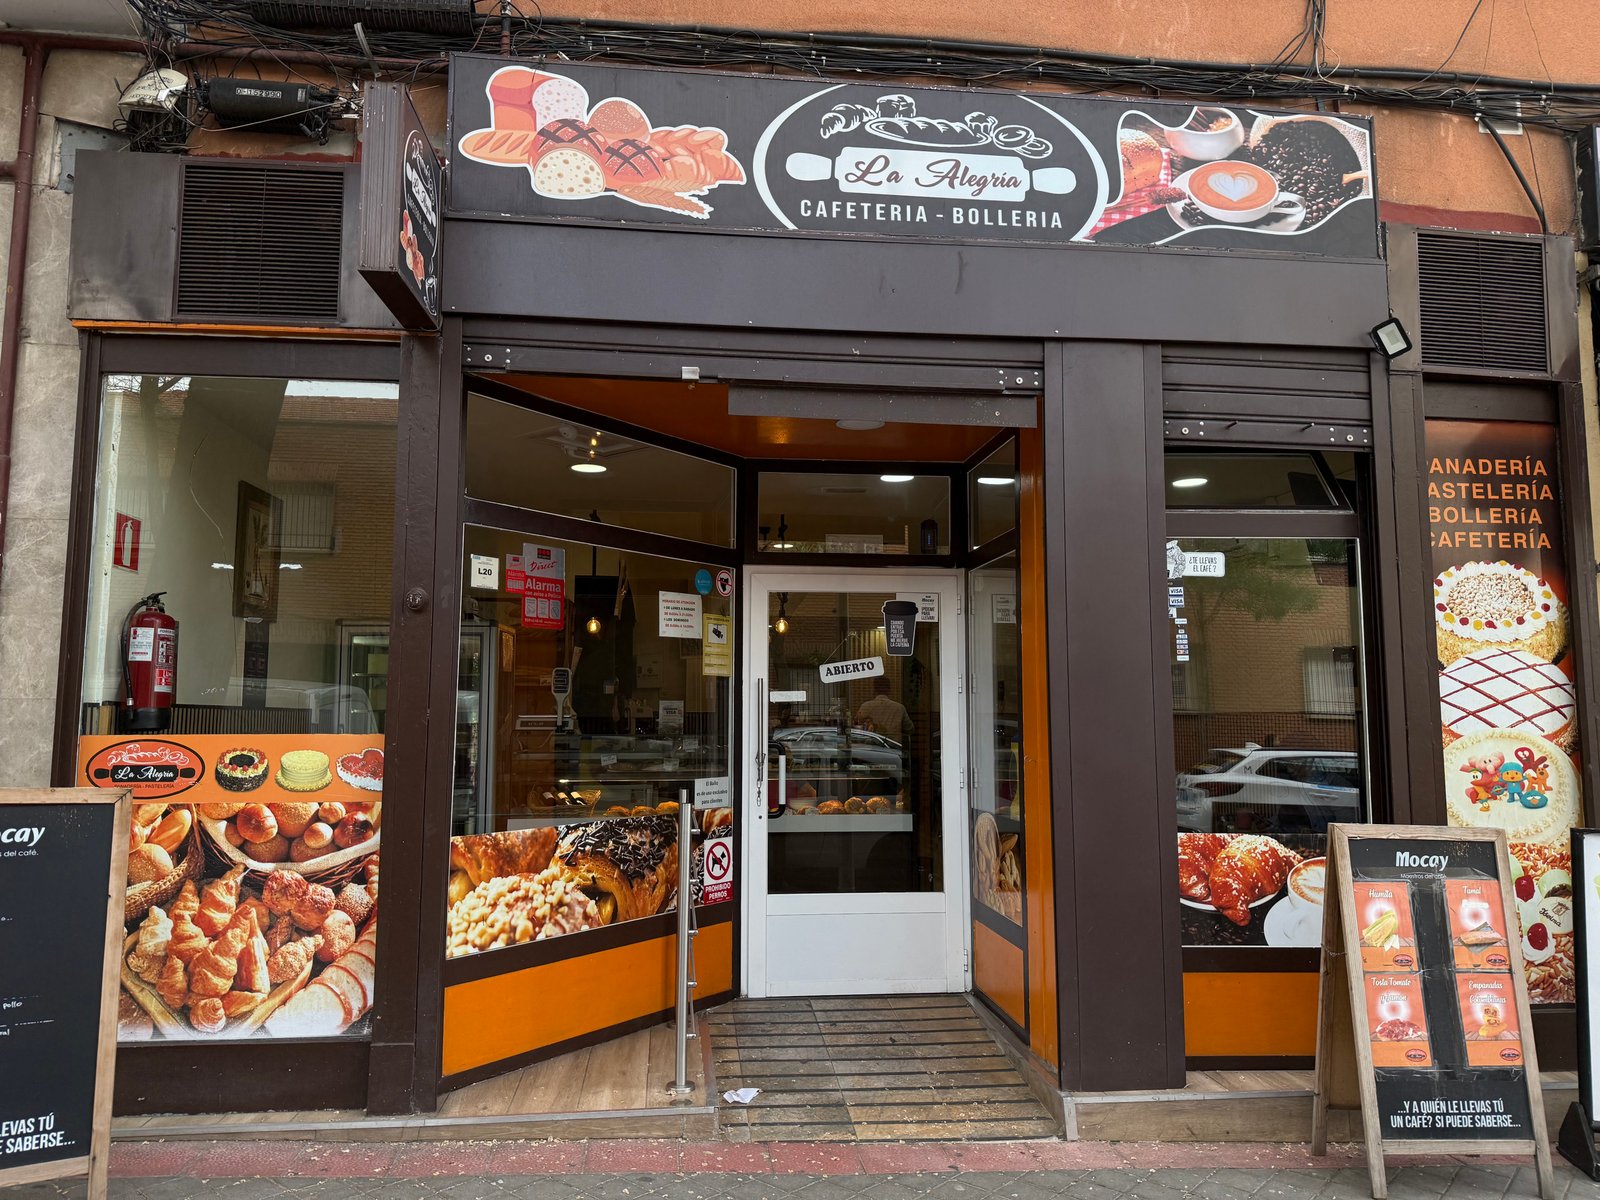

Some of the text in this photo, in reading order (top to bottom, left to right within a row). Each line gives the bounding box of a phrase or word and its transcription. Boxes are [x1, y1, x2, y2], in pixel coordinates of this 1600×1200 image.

[845, 155, 1022, 197] La Alegría
[800, 199, 928, 223] CAFETERIA
[952, 207, 1063, 229] BOLLERIA
[1427, 456, 1548, 476] ANADERÍA
[478, 568, 492, 576] L20
[526, 578, 561, 592] Alarma
[825, 661, 874, 676] ABIERTO
[114, 766, 135, 780] La
[1396, 852, 1448, 871] Mocay
[705, 882, 731, 893] PROHIBIDO
[1369, 889, 1393, 898] Humita
[1462, 886, 1482, 894] Tamal
[709, 890, 727, 900] PERROS
[1468, 980, 1503, 990] Empanadas
[1413, 1102, 1419, 1113] A
[1420, 1098, 1447, 1114] QUIÉN
[1449, 1101, 1459, 1113] LE
[1460, 1101, 1492, 1113] LLEVAS
[1493, 1098, 1504, 1112] TÚ
[38, 1112, 55, 1131] TÚ
[1391, 1114, 1521, 1128] UN CAFÉ? SI PUEDE SABERSE...
[6, 1131, 75, 1154] SABERSE...
